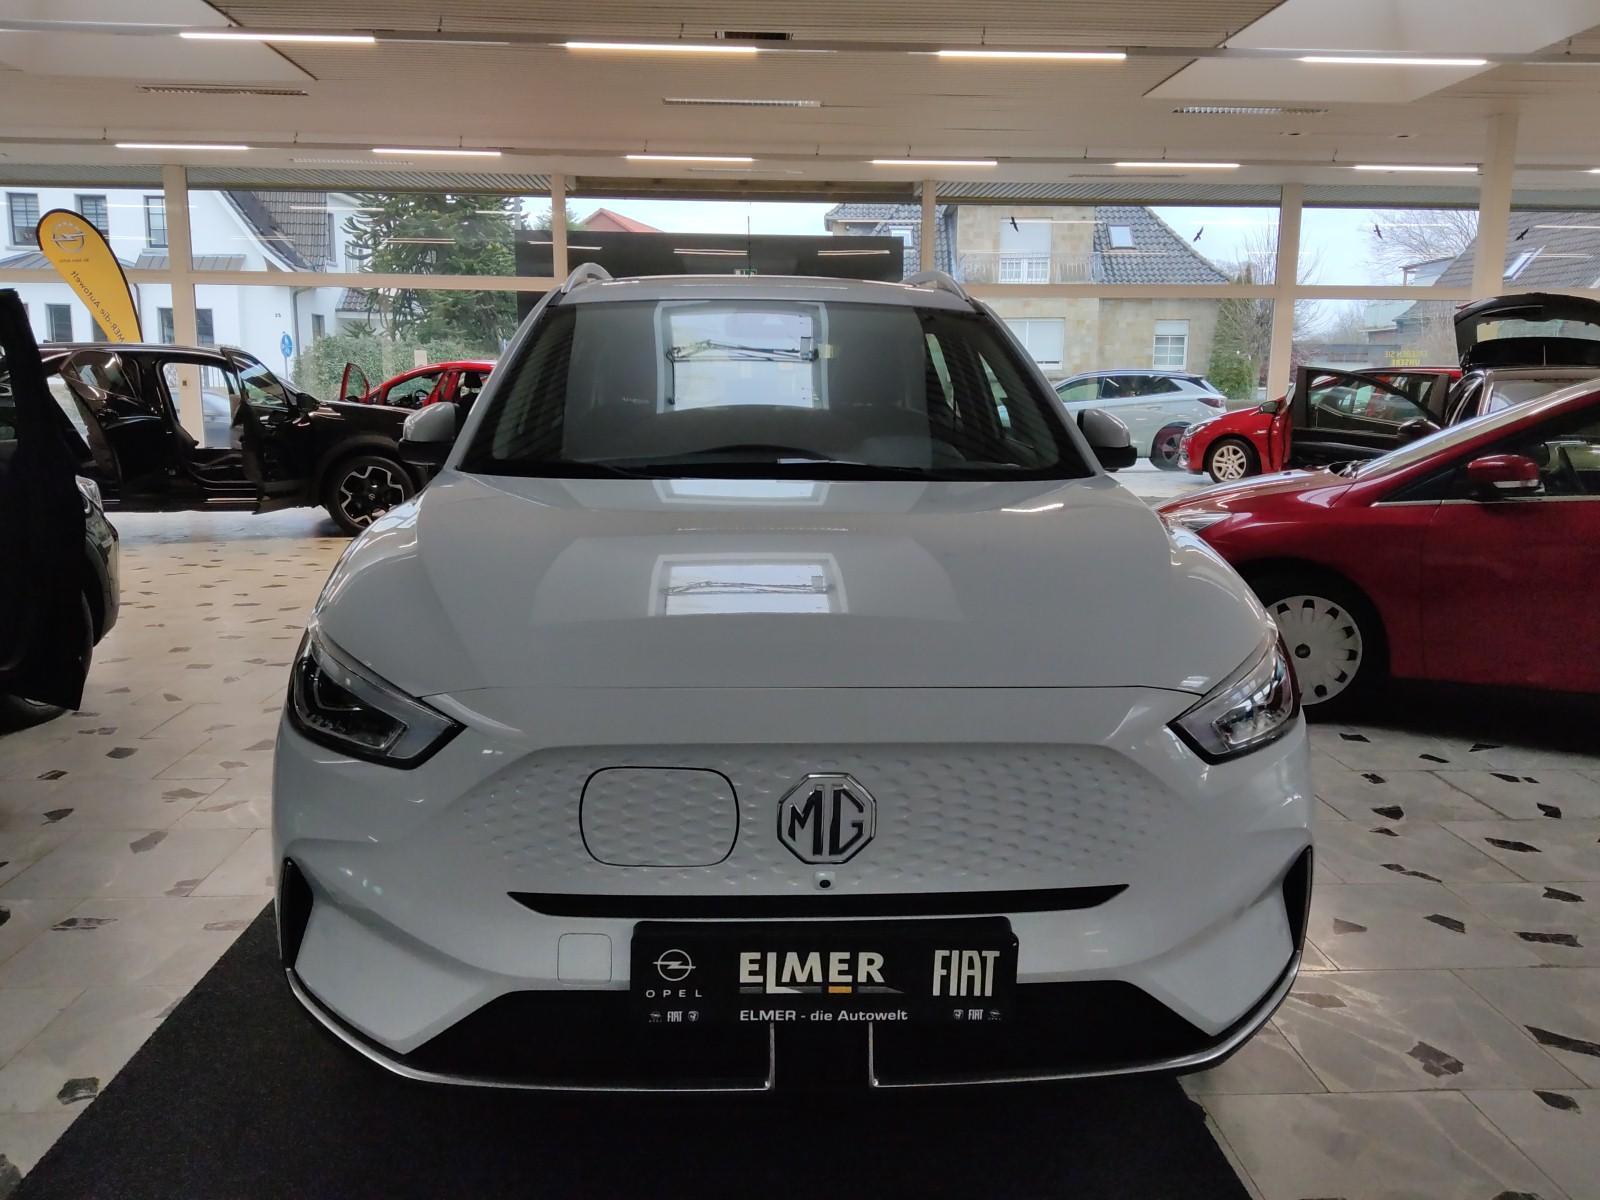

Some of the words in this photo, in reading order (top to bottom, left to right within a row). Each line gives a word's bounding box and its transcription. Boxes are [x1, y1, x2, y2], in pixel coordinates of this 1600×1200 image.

[787, 784, 865, 856] MG
[739, 951, 886, 994] ELMER
[932, 949, 1001, 997] FIAT
[645, 988, 703, 998] OPEL
[667, 1010, 683, 1022] FIAT
[739, 1010, 796, 1021] ELMER
[810, 1010, 833, 1021] die
[838, 1009, 909, 1021] Autowelt
[967, 1008, 983, 1021] FIAT
